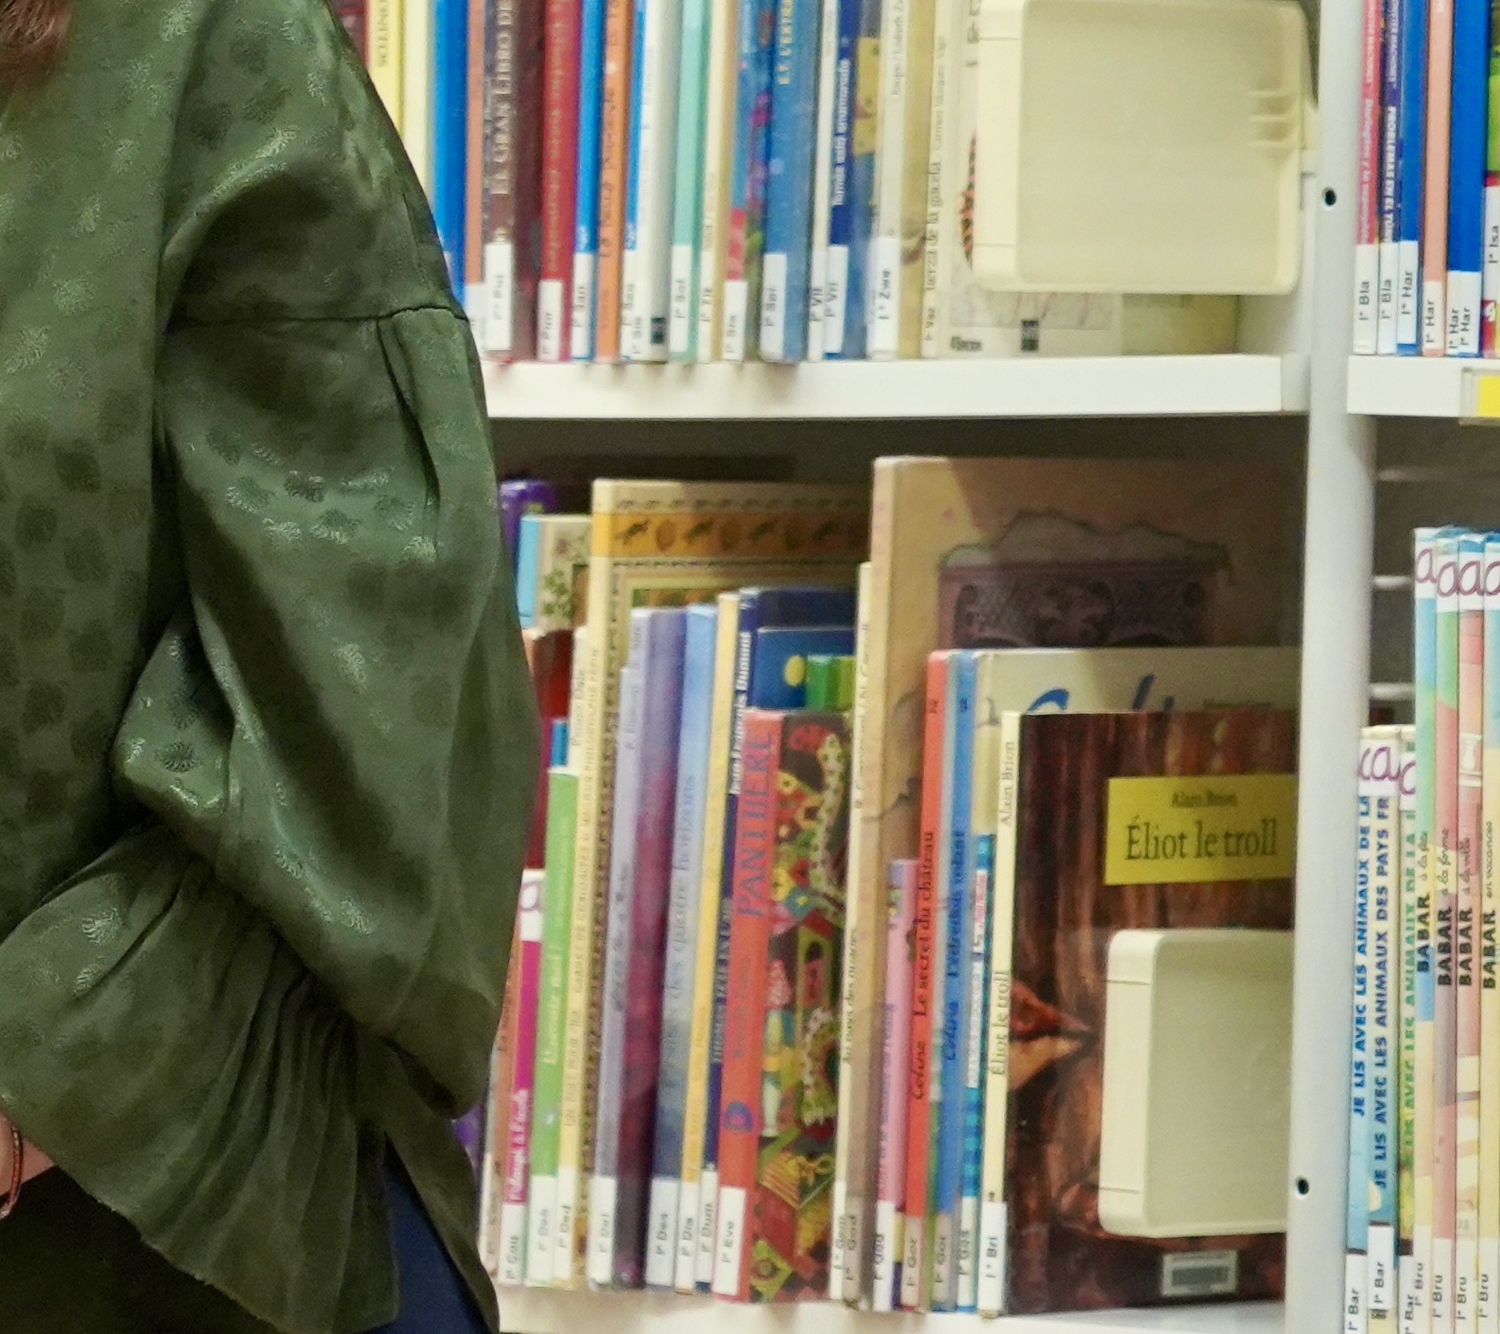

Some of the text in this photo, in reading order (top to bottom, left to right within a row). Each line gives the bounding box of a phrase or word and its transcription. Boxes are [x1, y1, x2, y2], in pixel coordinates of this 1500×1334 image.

[493, 0, 513, 165] GRAN LIBRO DE
[1385, 106, 1397, 178] PROBLEMAS
[735, 631, 751, 691] Dumont
[999, 741, 1015, 827] Alain Brion
[1125, 814, 1278, 861] Éliot le troll
[914, 830, 934, 1017] Le secret du château
[1416, 892, 1431, 974] BABAR
[1437, 906, 1453, 988] BABAR
[1457, 907, 1474, 989] BABAR
[1482, 908, 1497, 990] BABAR
[1354, 823, 1370, 1117] JE LIS AVEC LES ANIMAUX DE
[1375, 827, 1389, 1189] JE LIS AVEC LES ANIMAUX DES PAYS
[989, 970, 1010, 1076] Éliot le troll
